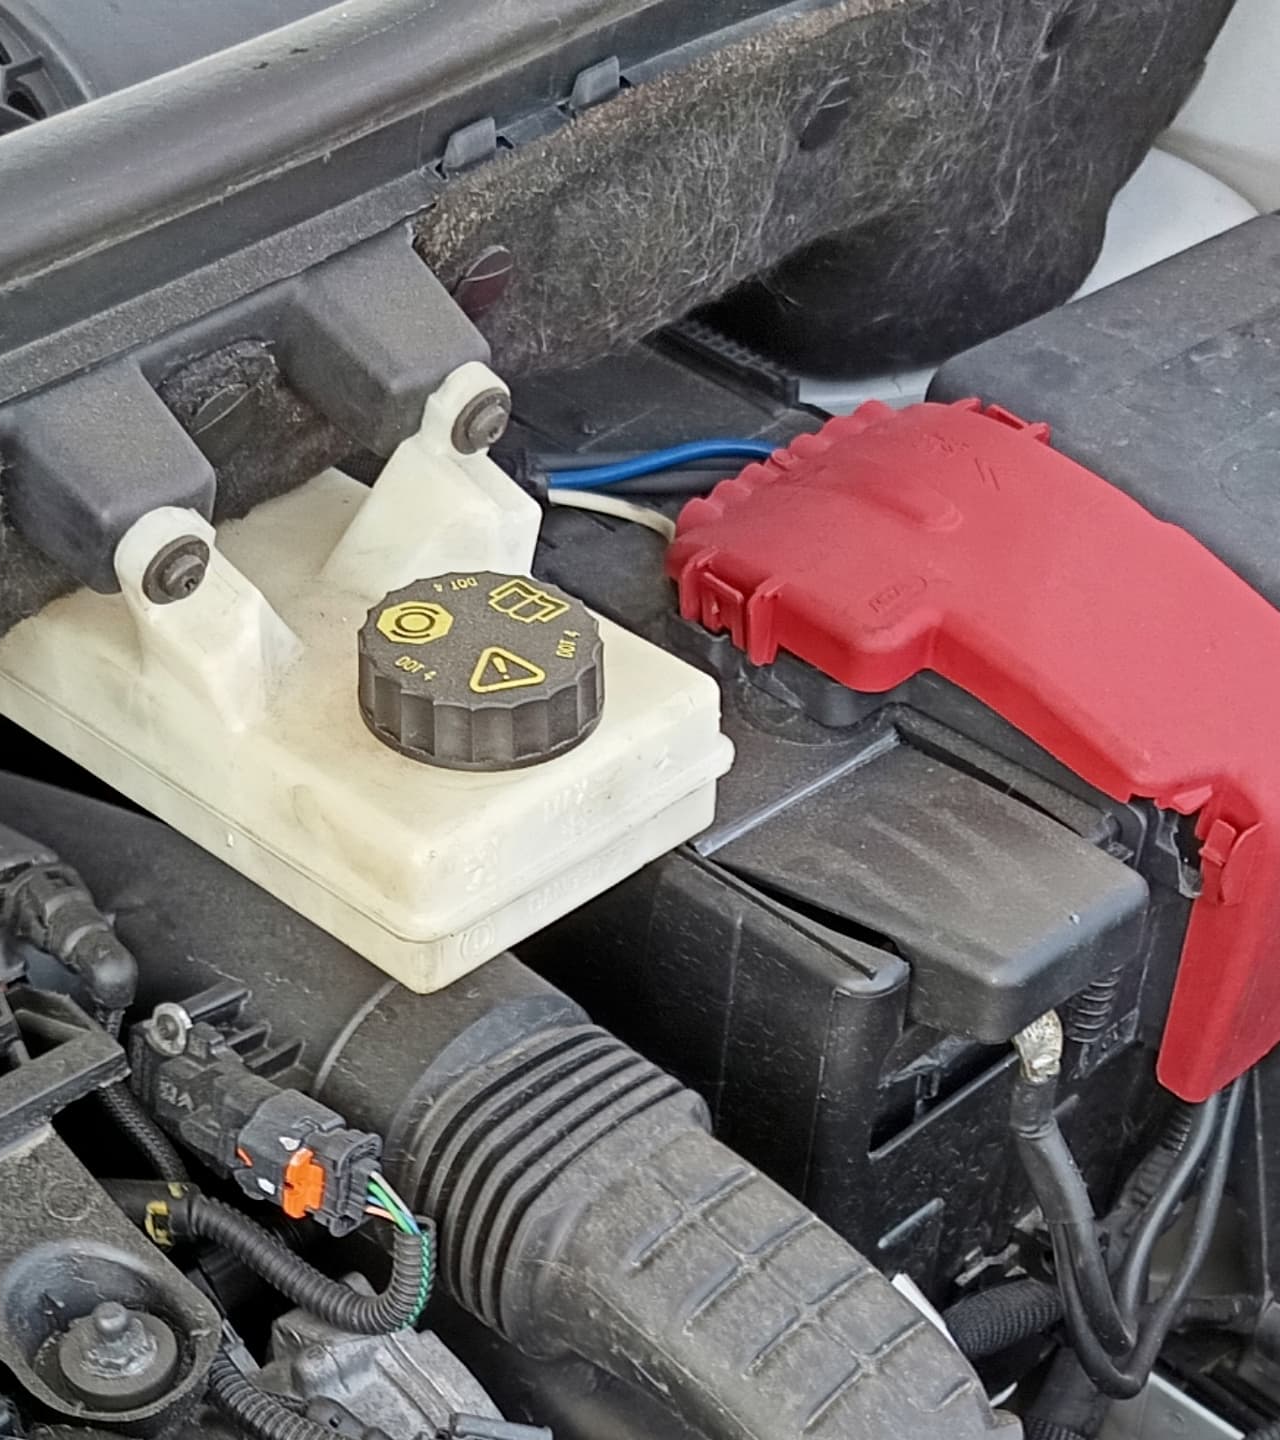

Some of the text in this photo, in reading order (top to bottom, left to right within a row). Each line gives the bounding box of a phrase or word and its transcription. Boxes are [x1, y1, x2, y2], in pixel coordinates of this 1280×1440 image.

[433, 577, 479, 593] DOT 4
[555, 640, 577, 659] DOT
[395, 655, 437, 683] DOT 4
